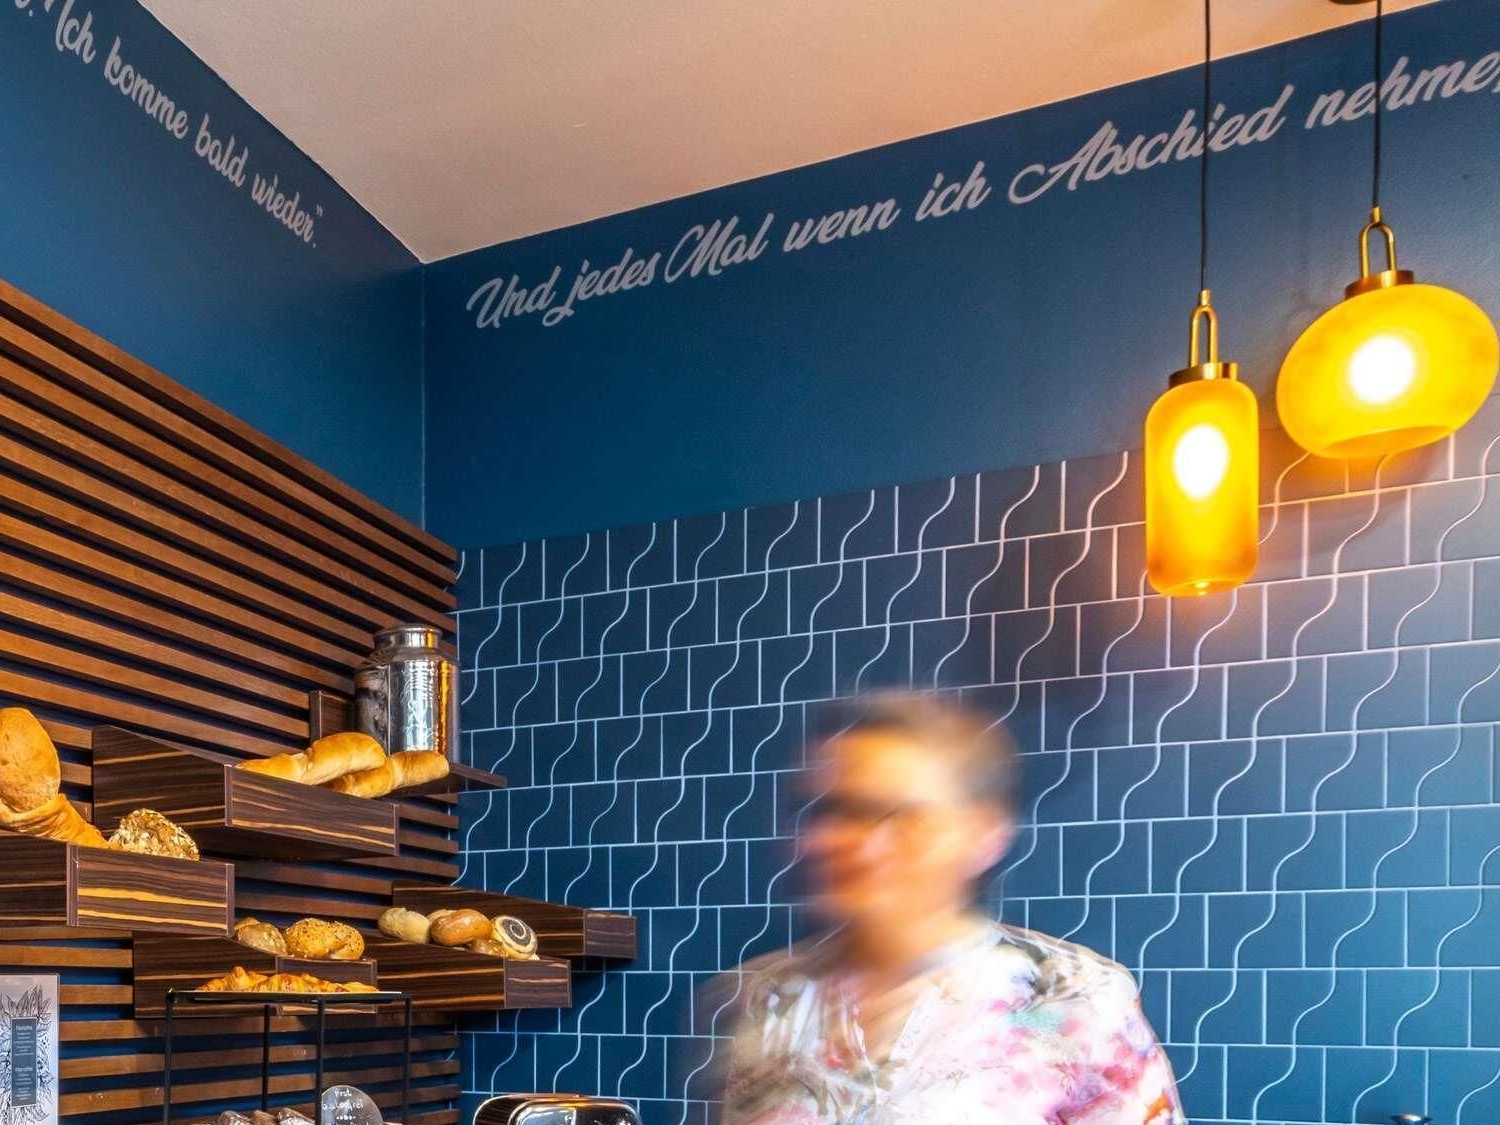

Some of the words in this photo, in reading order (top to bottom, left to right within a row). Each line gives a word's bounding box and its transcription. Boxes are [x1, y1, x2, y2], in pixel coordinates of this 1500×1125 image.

[103, 36, 188, 139] komme
[194, 113, 249, 188] bald
[465, 264, 561, 329] Und
[541, 247, 661, 327] jedes
[663, 211, 776, 284] Mal
[781, 197, 901, 254] wenn
[914, 160, 993, 223] ich
[1007, 84, 1295, 205] Abschied
[1304, 50, 1500, 129] nehme
